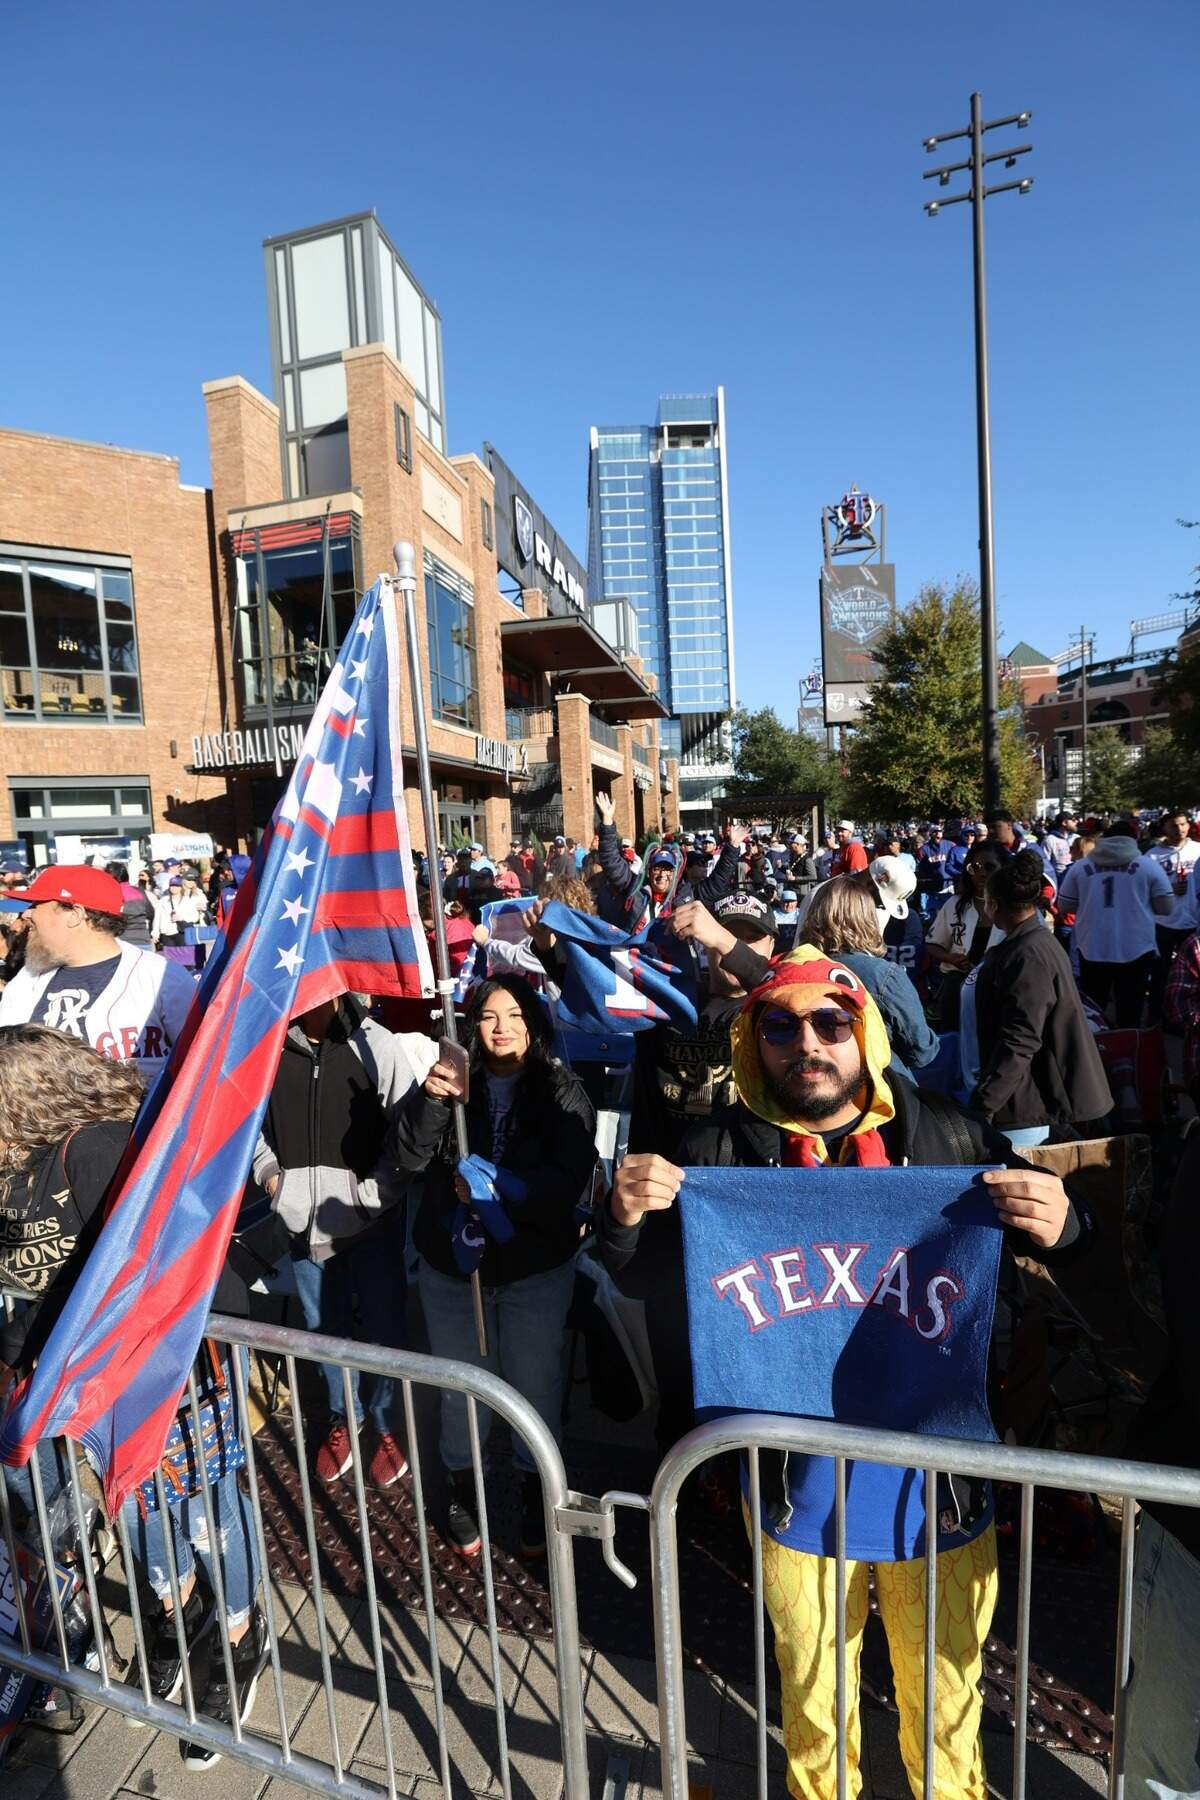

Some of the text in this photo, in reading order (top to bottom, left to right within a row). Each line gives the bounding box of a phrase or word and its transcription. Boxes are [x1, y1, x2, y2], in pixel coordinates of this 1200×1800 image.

[535, 532, 585, 612] RAM
[832, 611, 889, 622] CHAMPIONS
[192, 724, 304, 777] BASEBALLISM
[1102, 876, 1115, 908] 1
[711, 1242, 965, 1343] TEXAS
